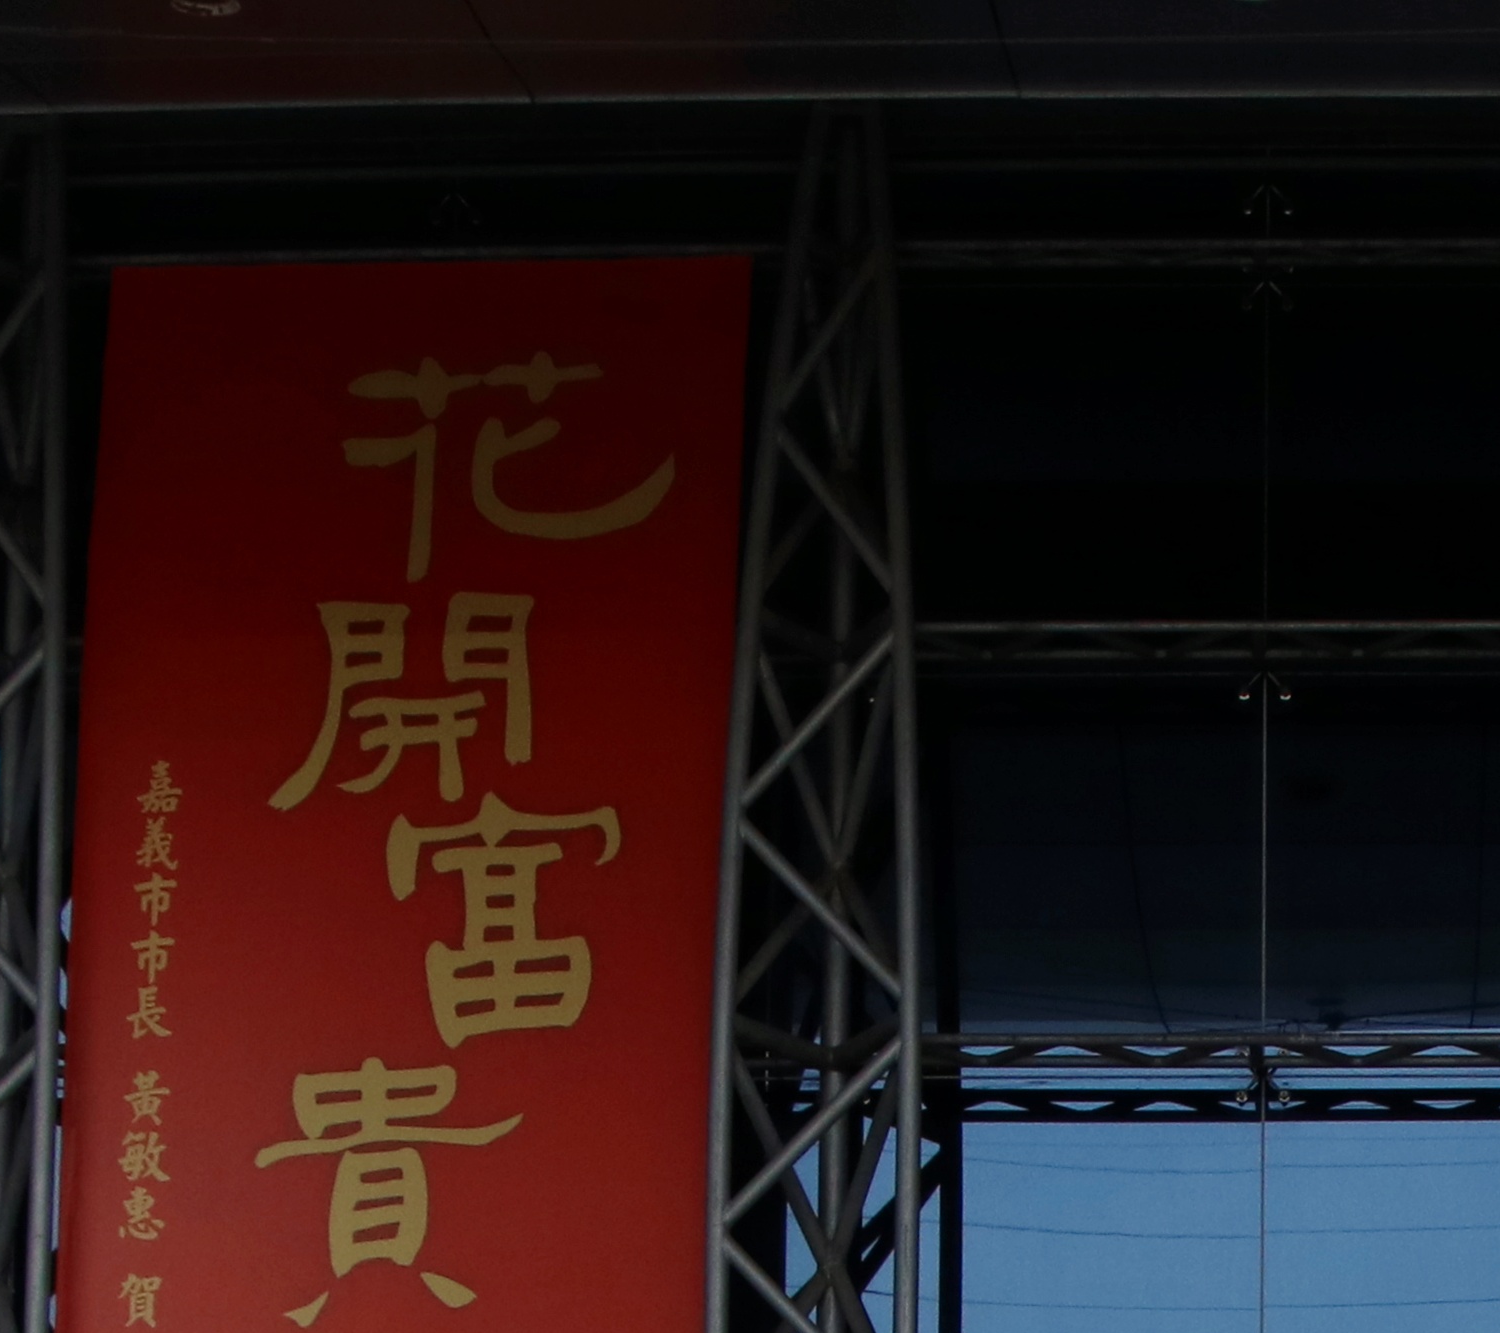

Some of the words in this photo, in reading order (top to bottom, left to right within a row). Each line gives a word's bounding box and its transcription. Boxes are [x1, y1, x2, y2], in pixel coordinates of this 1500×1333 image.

[125, 759, 183, 1041] 嘉義市市長
[254, 351, 675, 1327] 花開富貴
[117, 1070, 172, 1242] 黃敏惠
[117, 1272, 161, 1327] 賀
